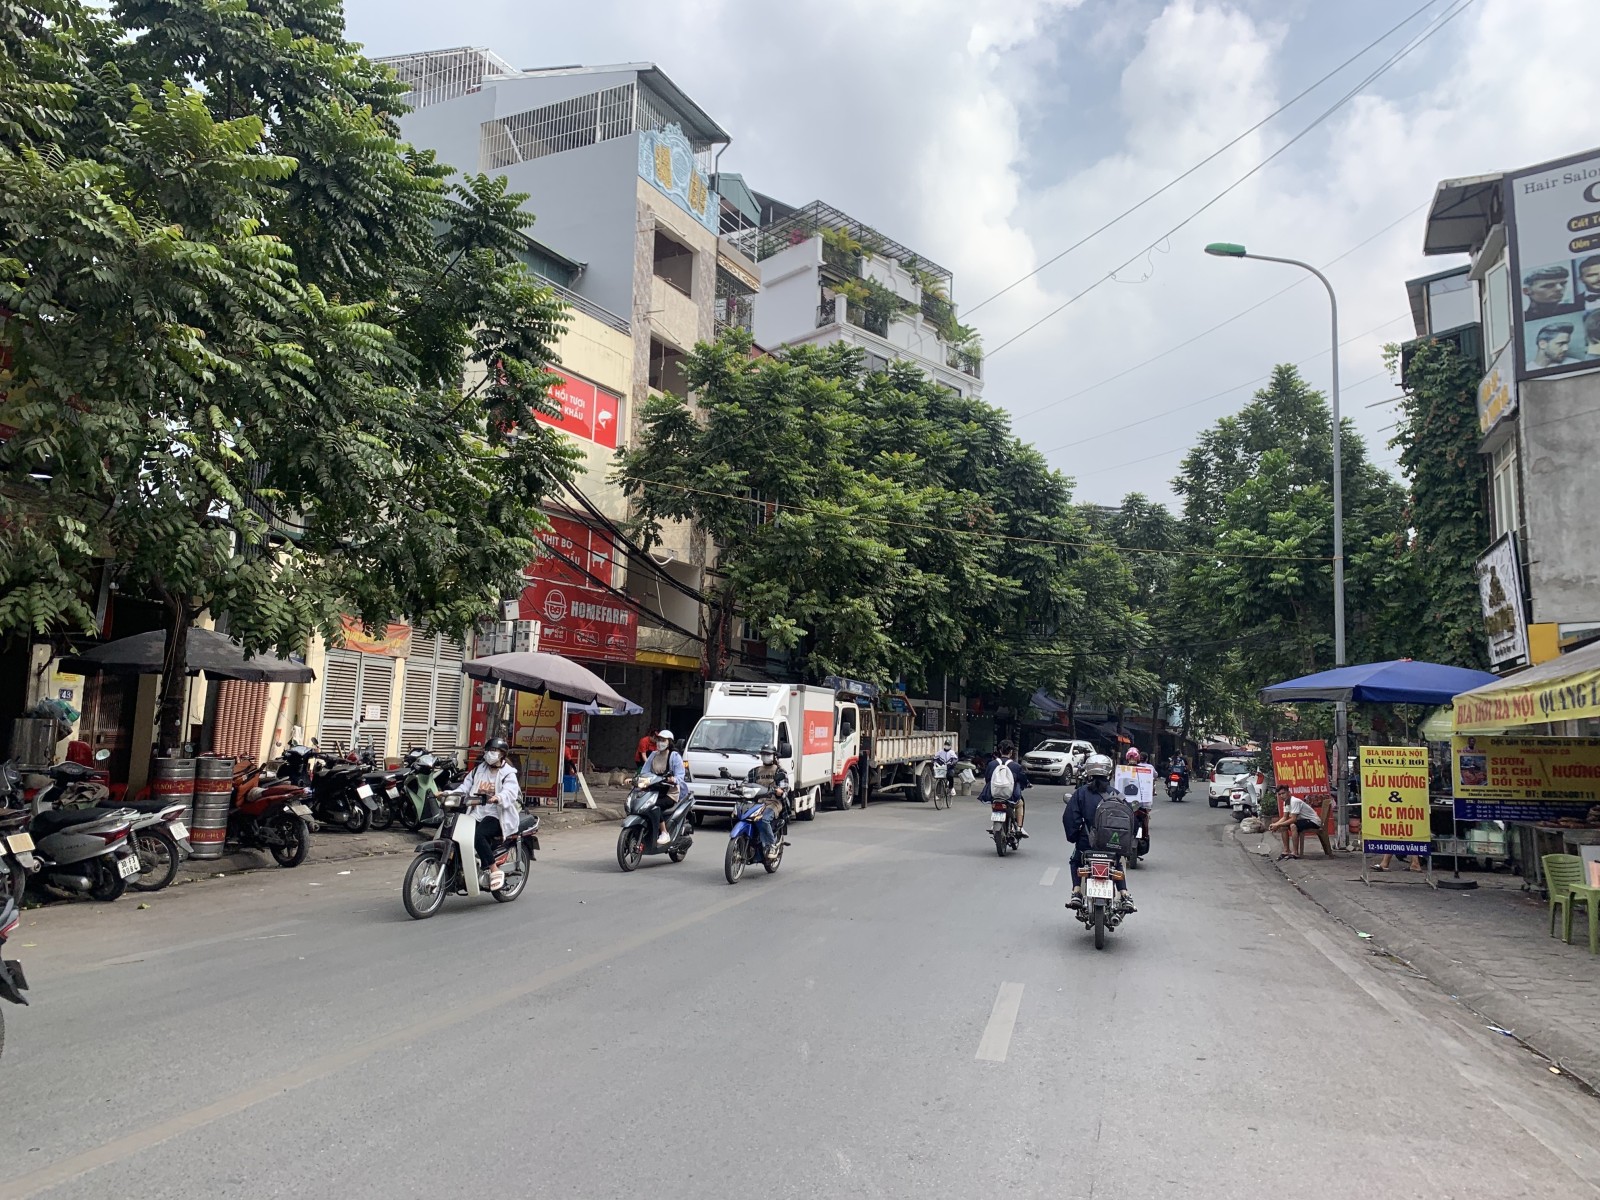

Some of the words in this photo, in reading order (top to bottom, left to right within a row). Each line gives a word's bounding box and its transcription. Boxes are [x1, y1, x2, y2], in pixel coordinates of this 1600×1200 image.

[1524, 178, 1558, 194] Hair
[570, 600, 629, 626] HOMEFARM
[522, 709, 555, 718] HABECO
[1457, 704, 1472, 725] BIA
[1365, 770, 1386, 787] LẨU
[1388, 772, 1426, 788] NƯỚNG
[1388, 791, 1403, 803] &
[1368, 804, 1393, 820] CÁC
[1396, 805, 1425, 821] MÓN
[1380, 821, 1414, 839] NHẬU
